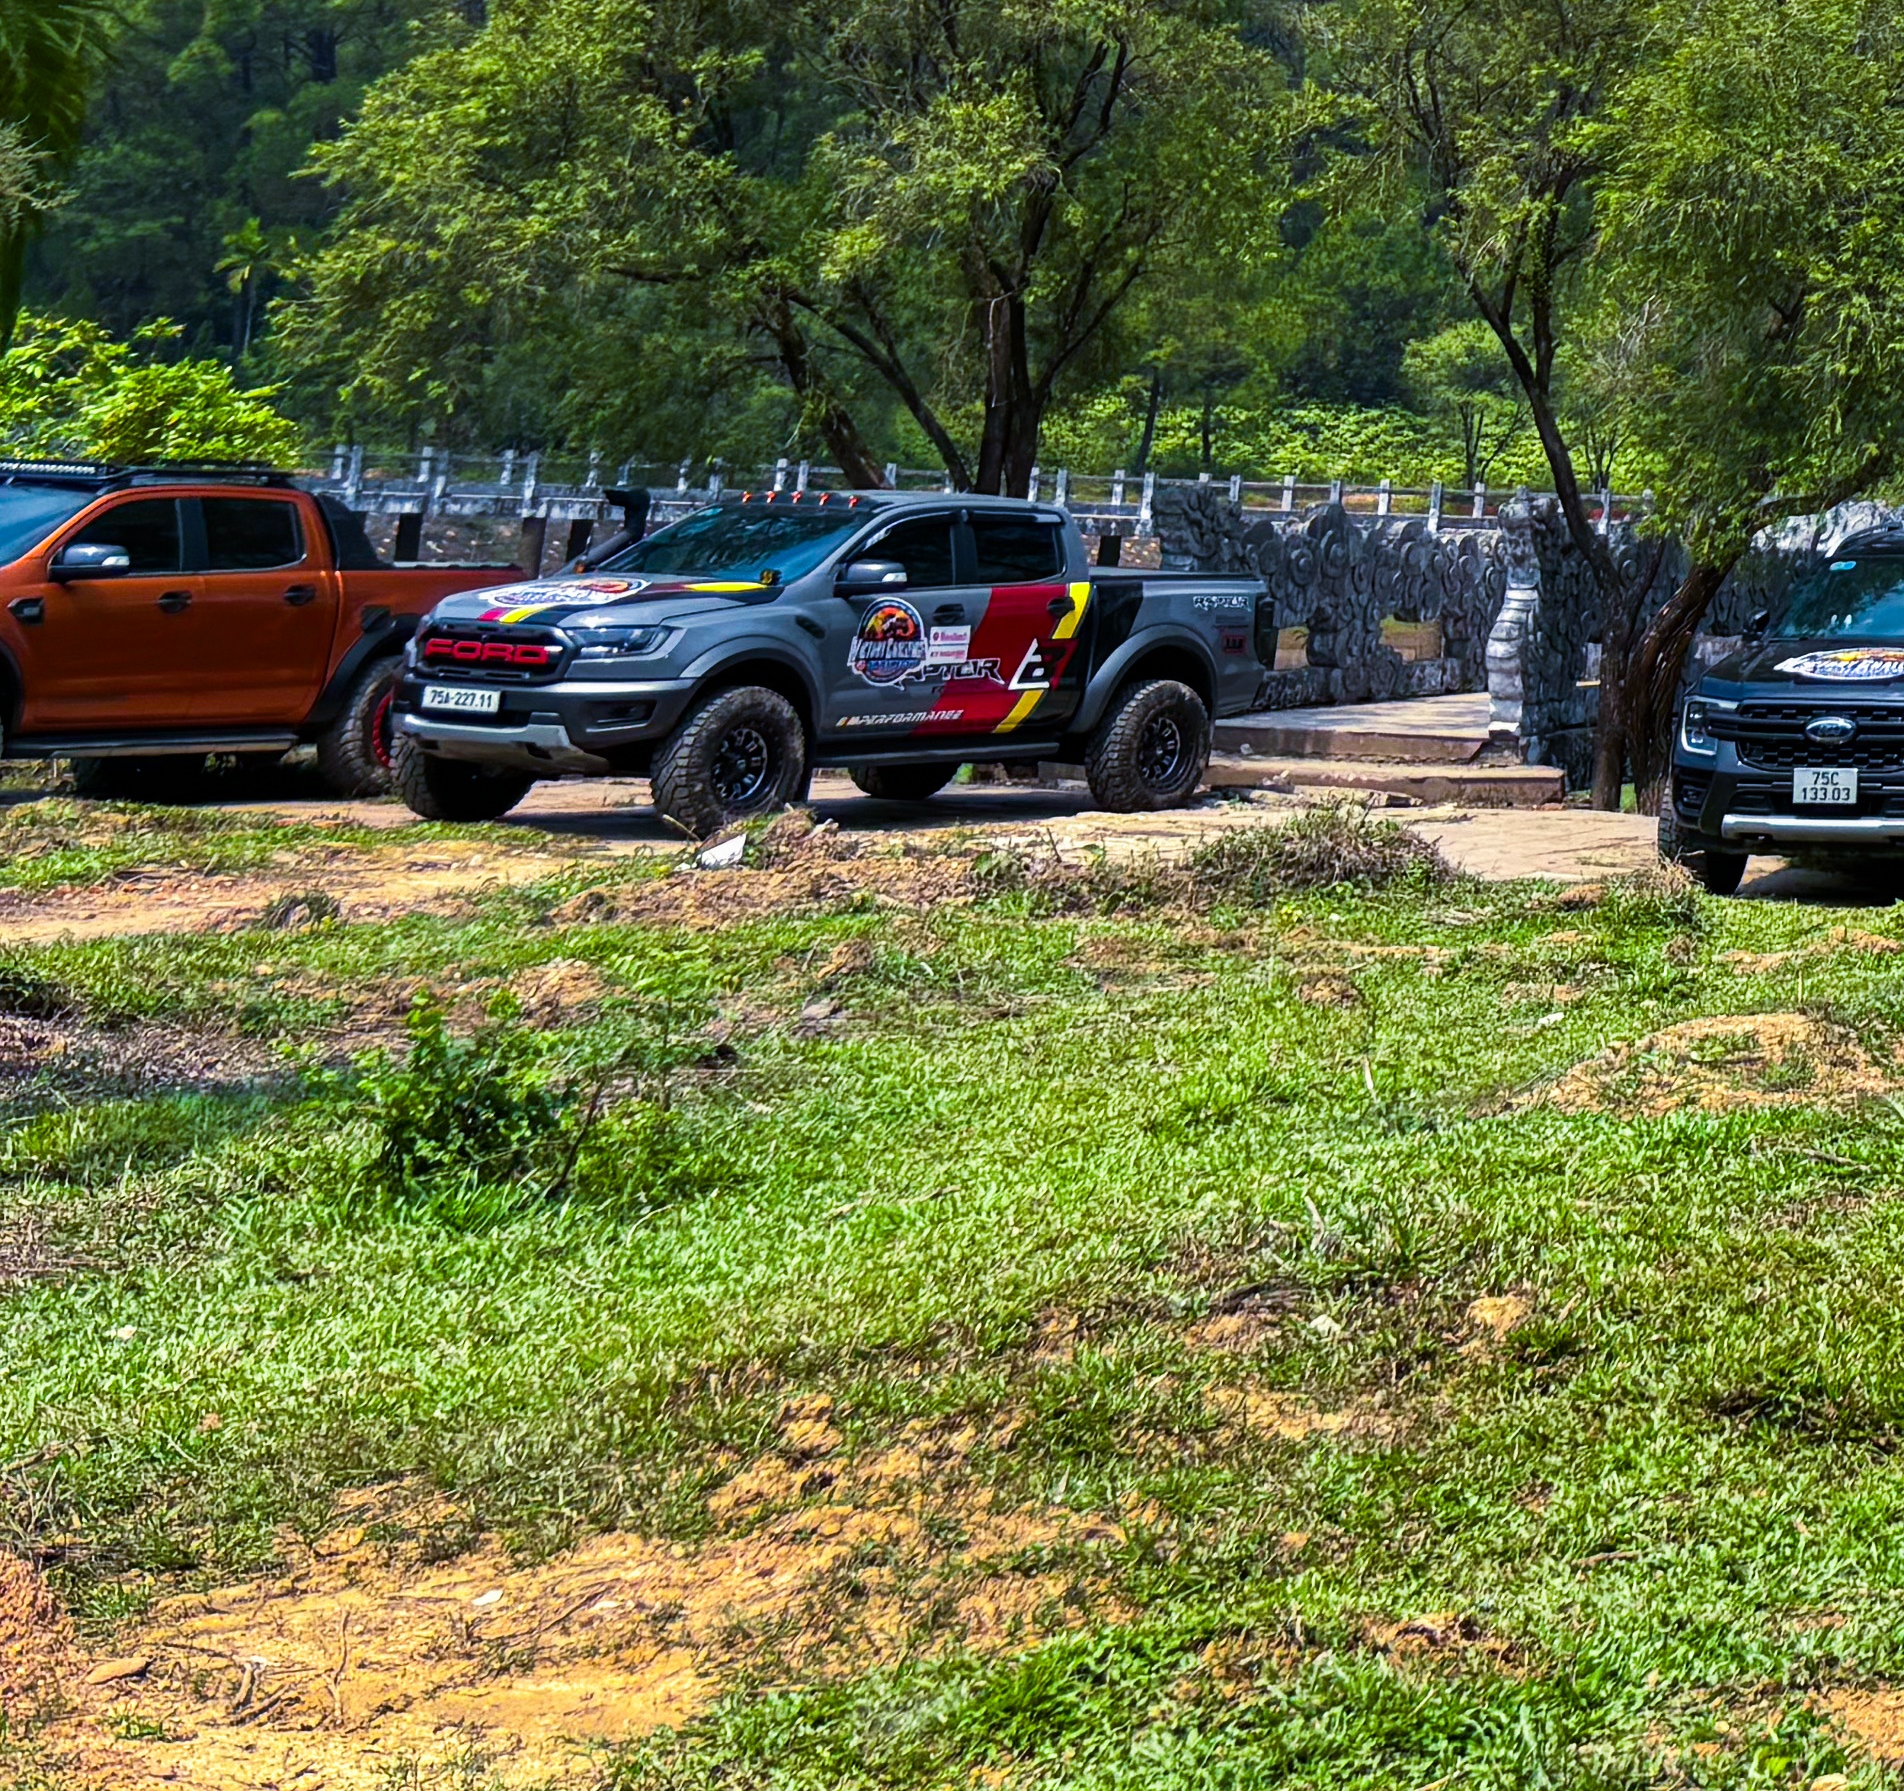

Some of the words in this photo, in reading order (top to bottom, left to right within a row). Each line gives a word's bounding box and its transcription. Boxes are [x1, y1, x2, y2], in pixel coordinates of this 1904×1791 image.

[424, 638, 549, 665] FORD
[430, 690, 493, 708] 75A-227.11
[1812, 771, 1840, 786] 75C
[1802, 786, 1851, 801] 133.03
